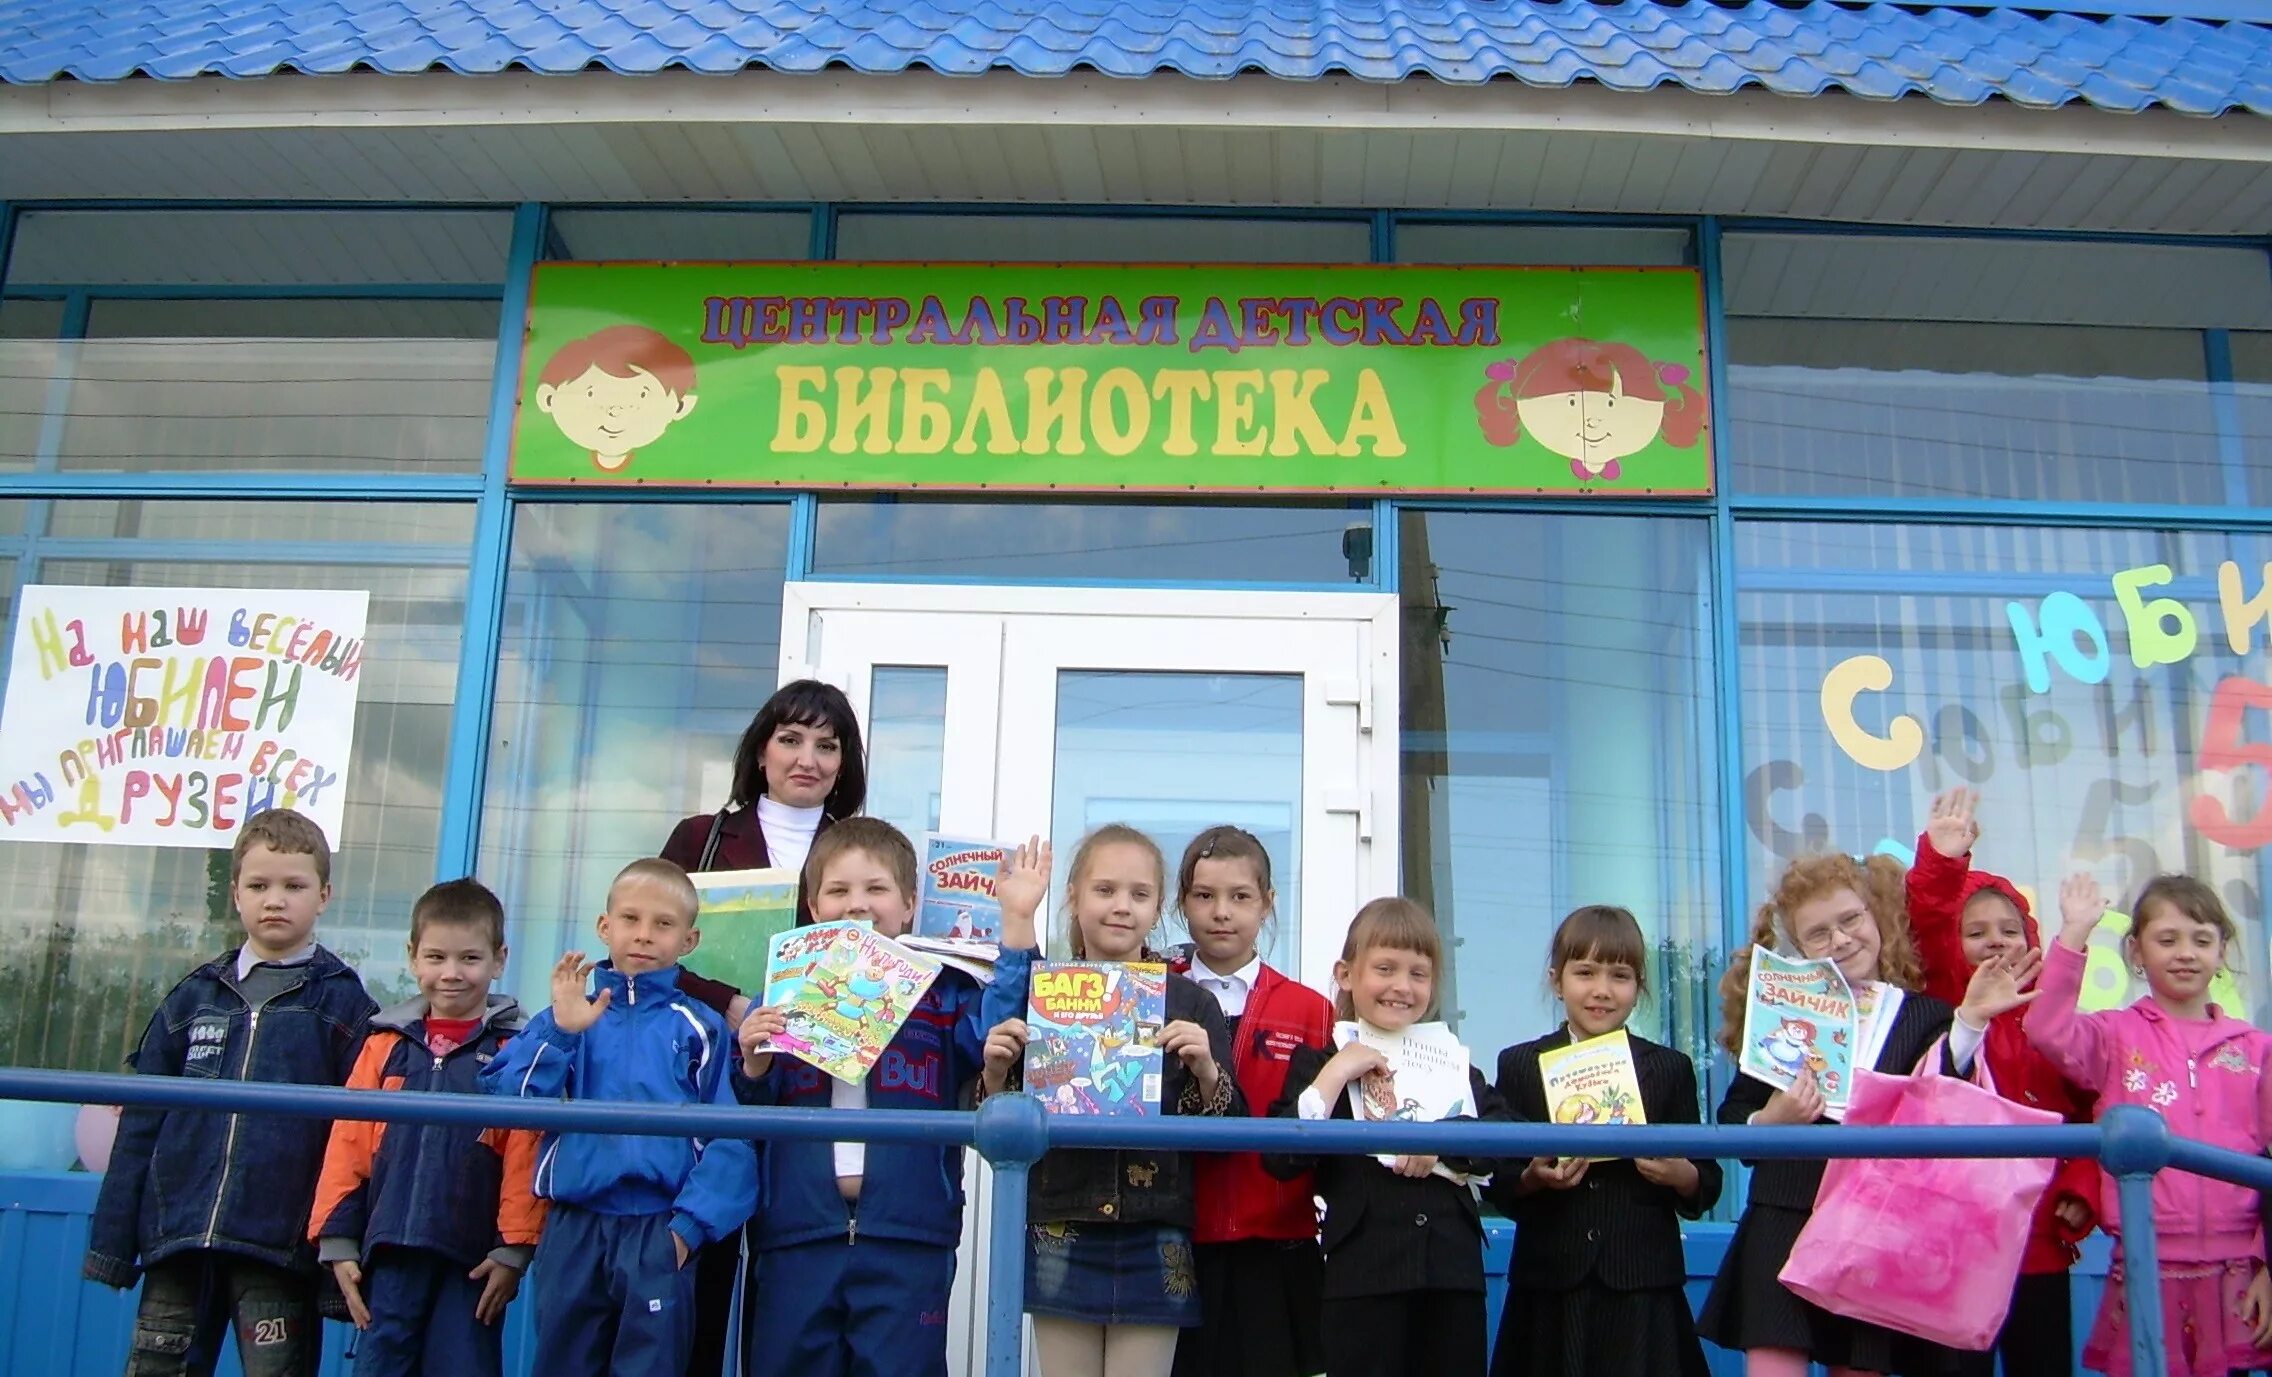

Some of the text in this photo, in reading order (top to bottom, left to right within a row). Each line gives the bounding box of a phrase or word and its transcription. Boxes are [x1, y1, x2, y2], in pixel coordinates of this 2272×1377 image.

[701, 295, 1501, 353] ЦЕНТРАЛЬНАЯ ДЕТСКАЯ
[770, 365, 1407, 457] БИБЛИОТЕКА
[1821, 655, 1923, 771] С
[60, 726, 244, 787] ПРИГЛАШАЕМ
[929, 848, 1003, 874] СОЛНЕЧНЫЙ
[937, 870, 998, 898] ЗАЙЧ
[1045, 997, 1102, 1012] БАННИ
[1765, 982, 1850, 1019] ЗАЙЧИК
[255, 1316, 288, 1346] 21
